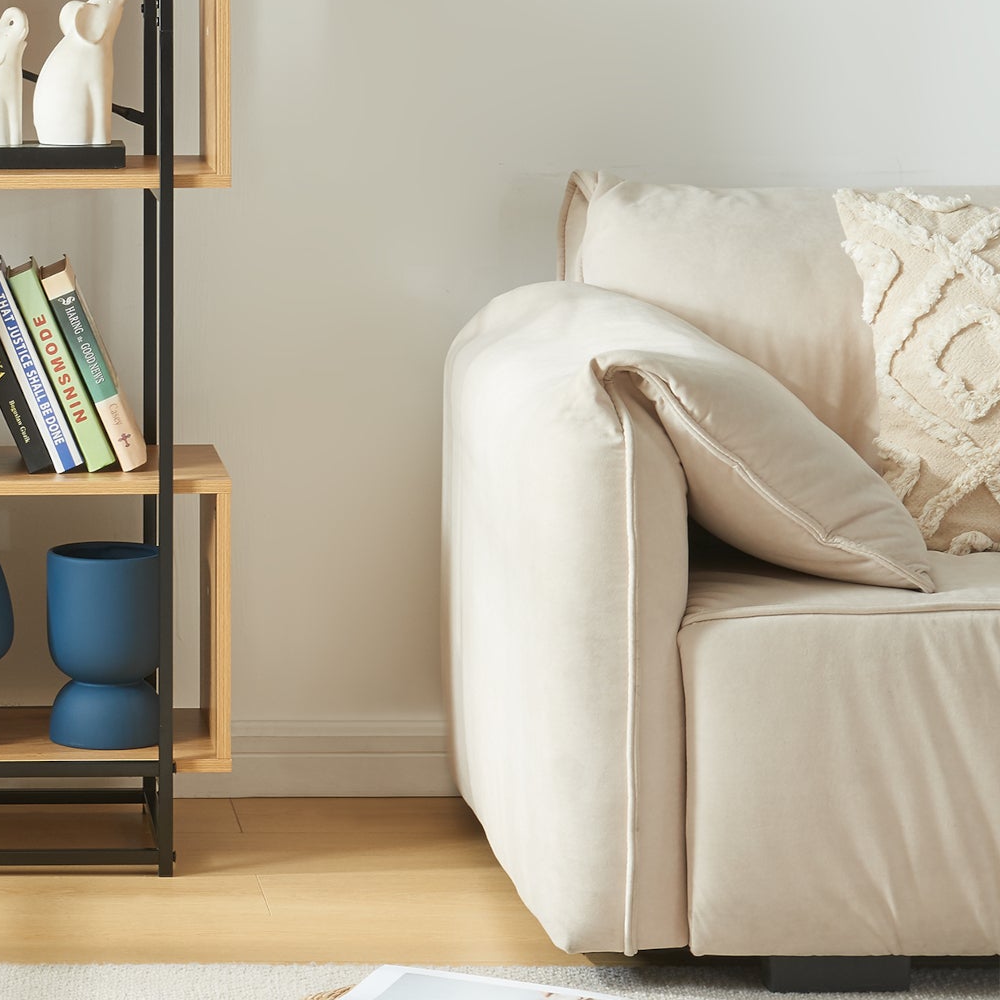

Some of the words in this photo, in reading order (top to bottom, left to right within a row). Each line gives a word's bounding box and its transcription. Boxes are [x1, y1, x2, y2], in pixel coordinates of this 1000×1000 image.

[8, 325, 33, 368] JUSTICE
[26, 368, 43, 403] SHALL
[40, 401, 51, 417] BE
[46, 415, 65, 446] DONE
[32, 314, 88, 424] NINSMODE
[80, 343, 96, 364] GOOD
[89, 363, 105, 384] NEWS
[108, 403, 123, 426] Casey
